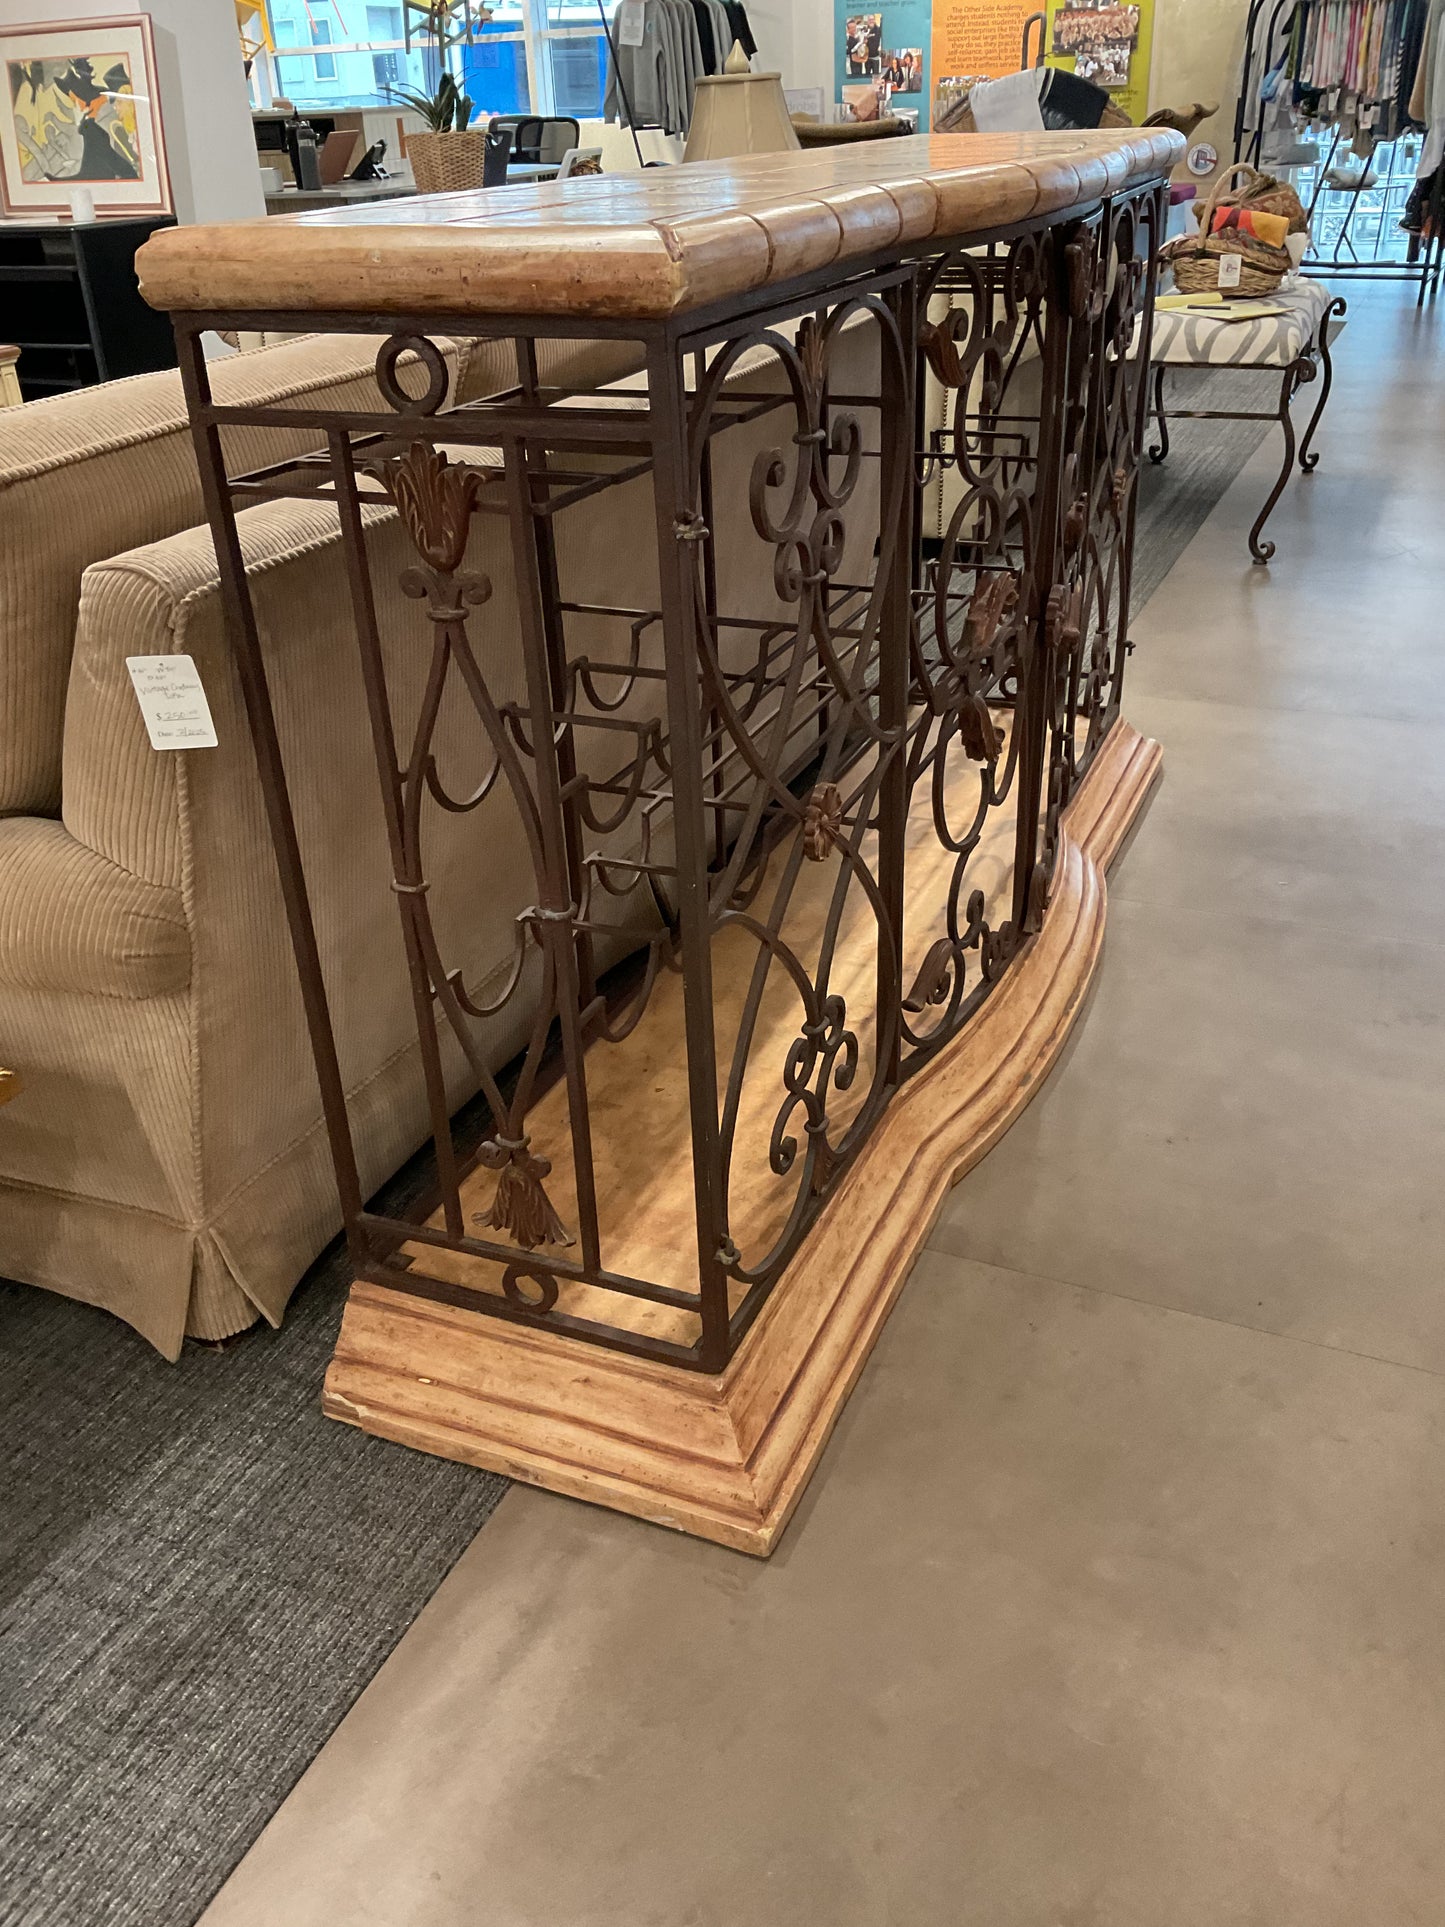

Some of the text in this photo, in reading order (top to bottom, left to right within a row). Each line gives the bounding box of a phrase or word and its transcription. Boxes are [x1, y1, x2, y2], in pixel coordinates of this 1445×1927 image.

[996, 4, 1023, 12] Academy
[946, 14, 969, 22] charges
[997, 11, 1021, 19] nothing
[964, 27, 997, 35] enterprises
[948, 34, 970, 42] support
[998, 40, 1022, 48] practice
[1004, 53, 1021, 61] pride
